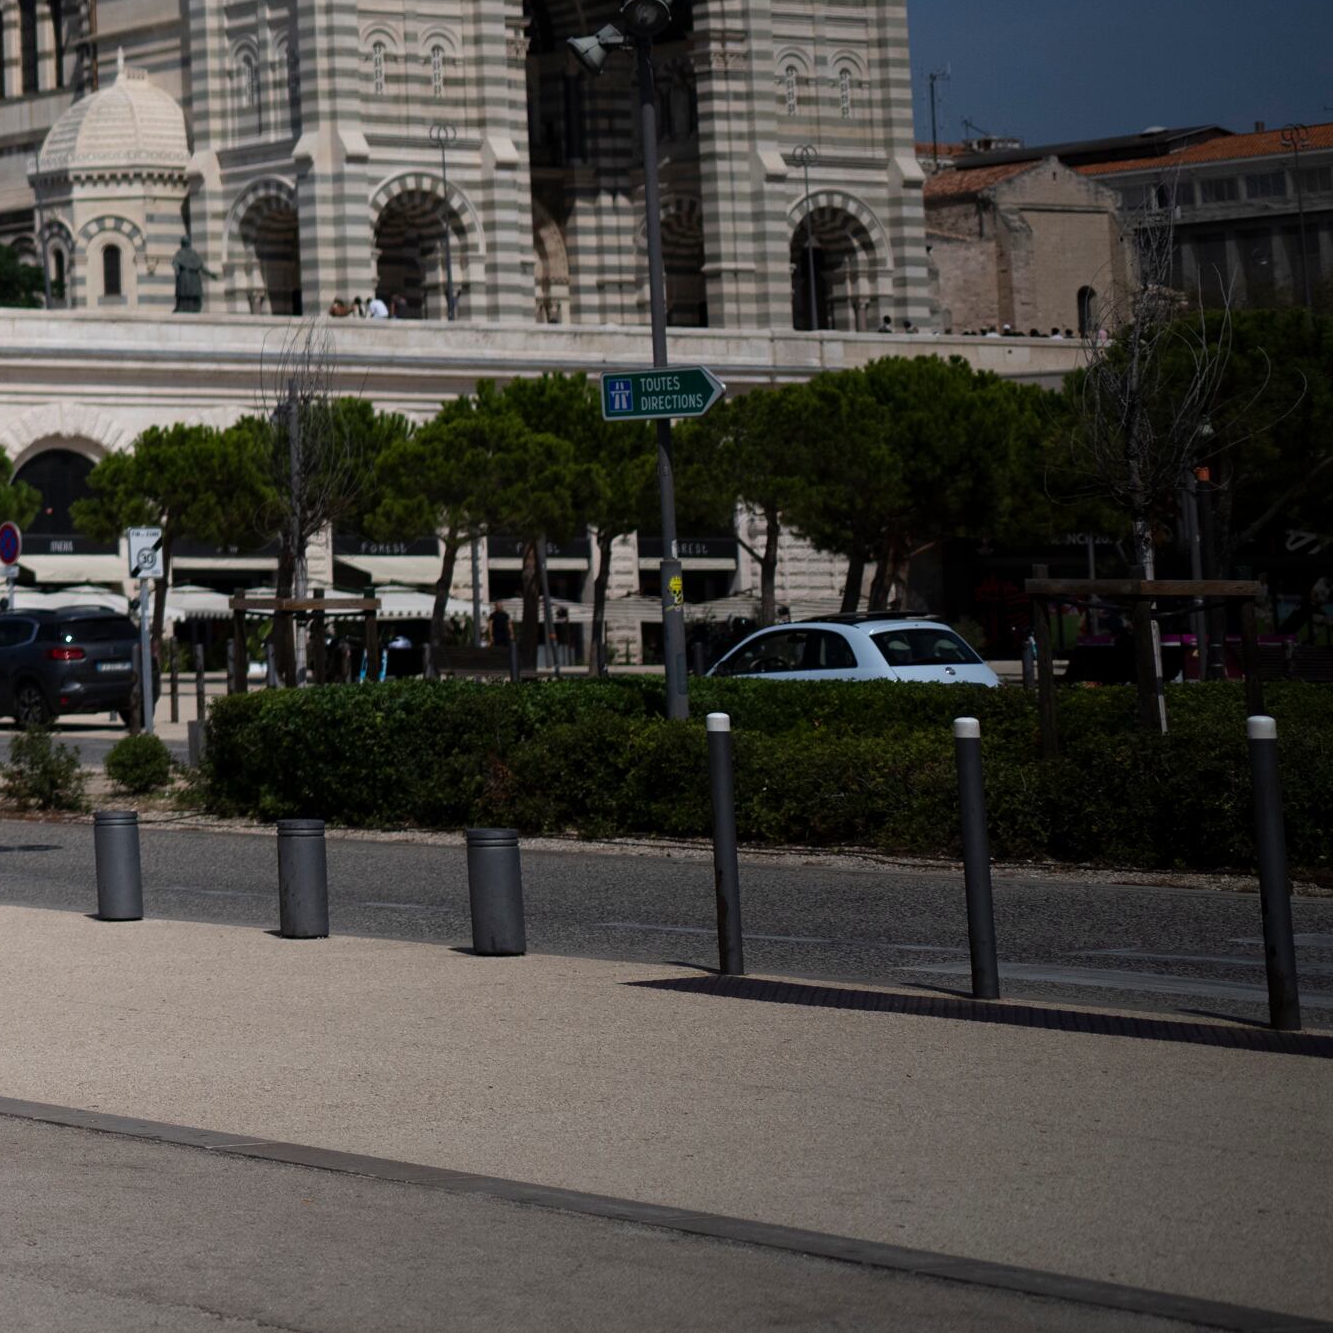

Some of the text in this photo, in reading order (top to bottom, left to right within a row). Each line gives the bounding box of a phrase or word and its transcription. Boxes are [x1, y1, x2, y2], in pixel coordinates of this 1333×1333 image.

[639, 376, 681, 392] TOUTES
[641, 393, 704, 411] DIRECTIONS
[140, 553, 154, 564] 30
